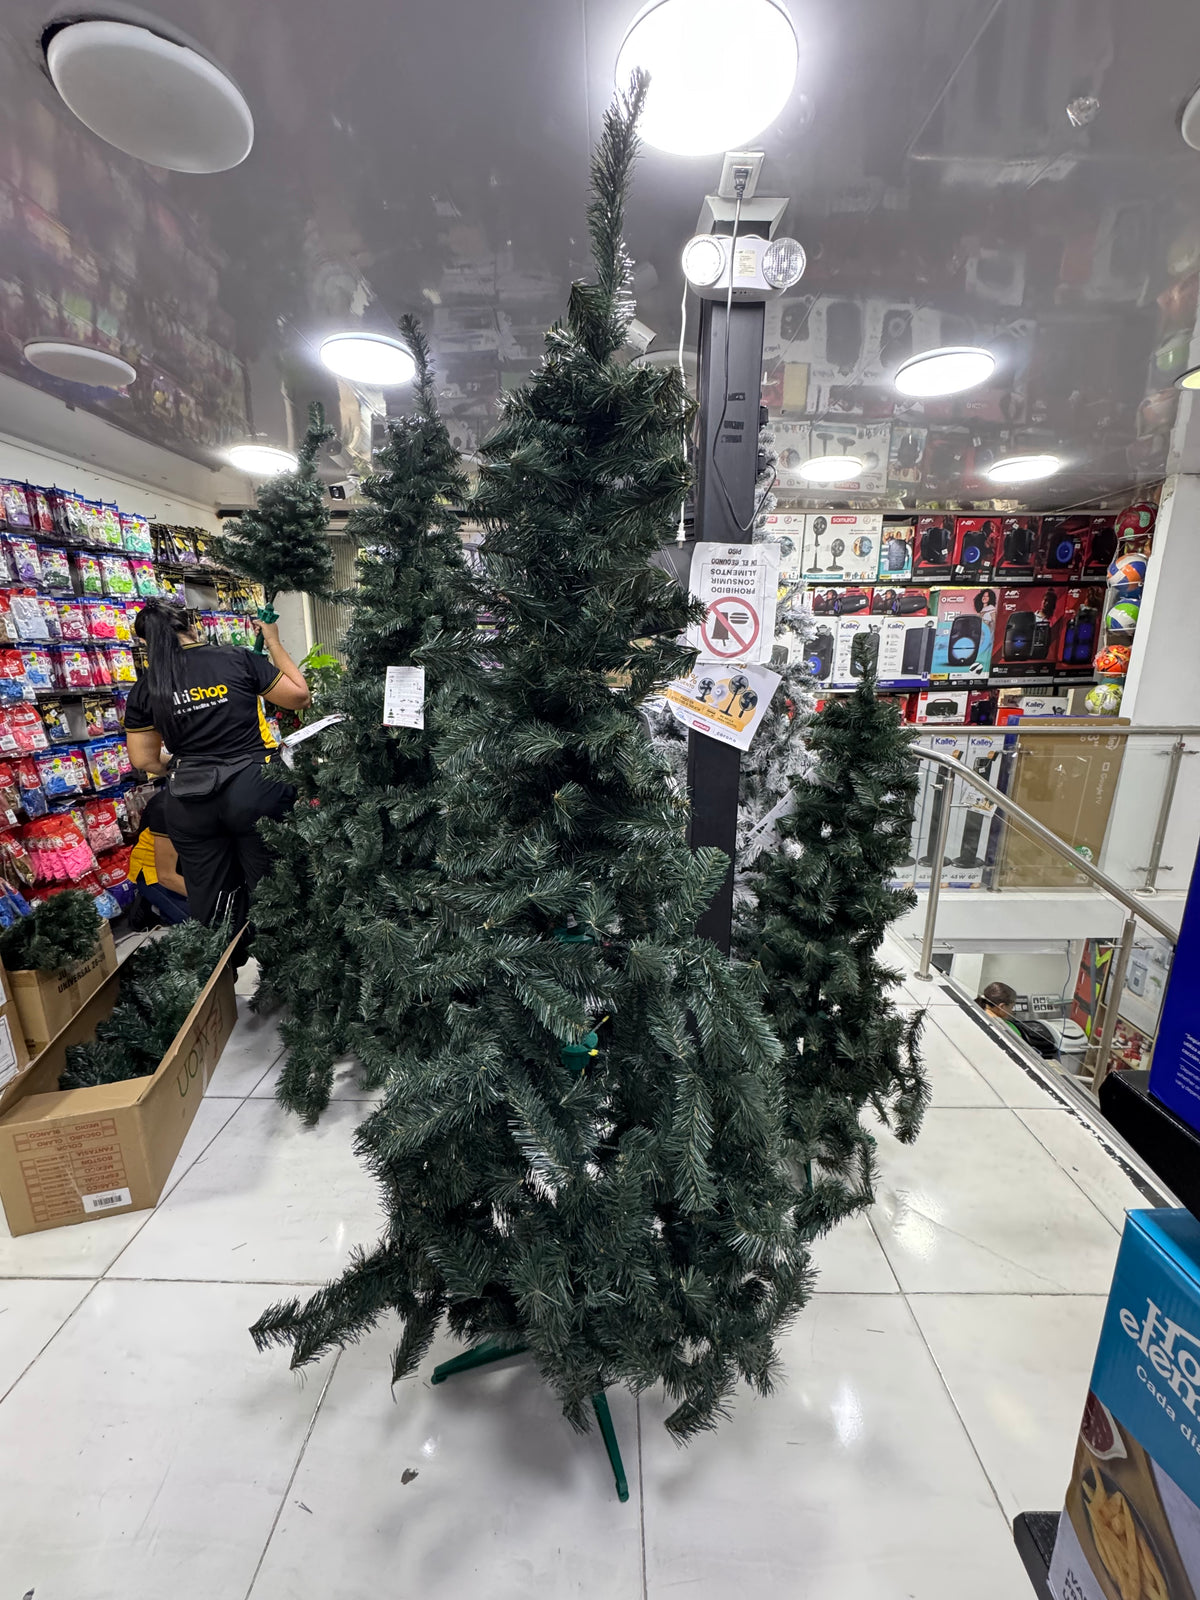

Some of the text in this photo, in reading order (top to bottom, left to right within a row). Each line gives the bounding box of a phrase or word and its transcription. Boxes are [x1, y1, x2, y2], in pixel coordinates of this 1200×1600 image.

[710, 568, 757, 576] ALIMENTOS
[711, 587, 756, 595] PROHIBIDO
[841, 622, 860, 630] Kalley
[887, 622, 905, 630] Kalley
[935, 738, 958, 747] Kalley
[971, 738, 994, 747] Kalley
[57, 964, 92, 994] UNIVERSAL
[29, 1122, 100, 1139] MEDIO BLANCO
[37, 1131, 102, 1147] OSCURO CLARO
[57, 1142, 83, 1151] COLOR
[1136, 1364, 1176, 1422] Cada
